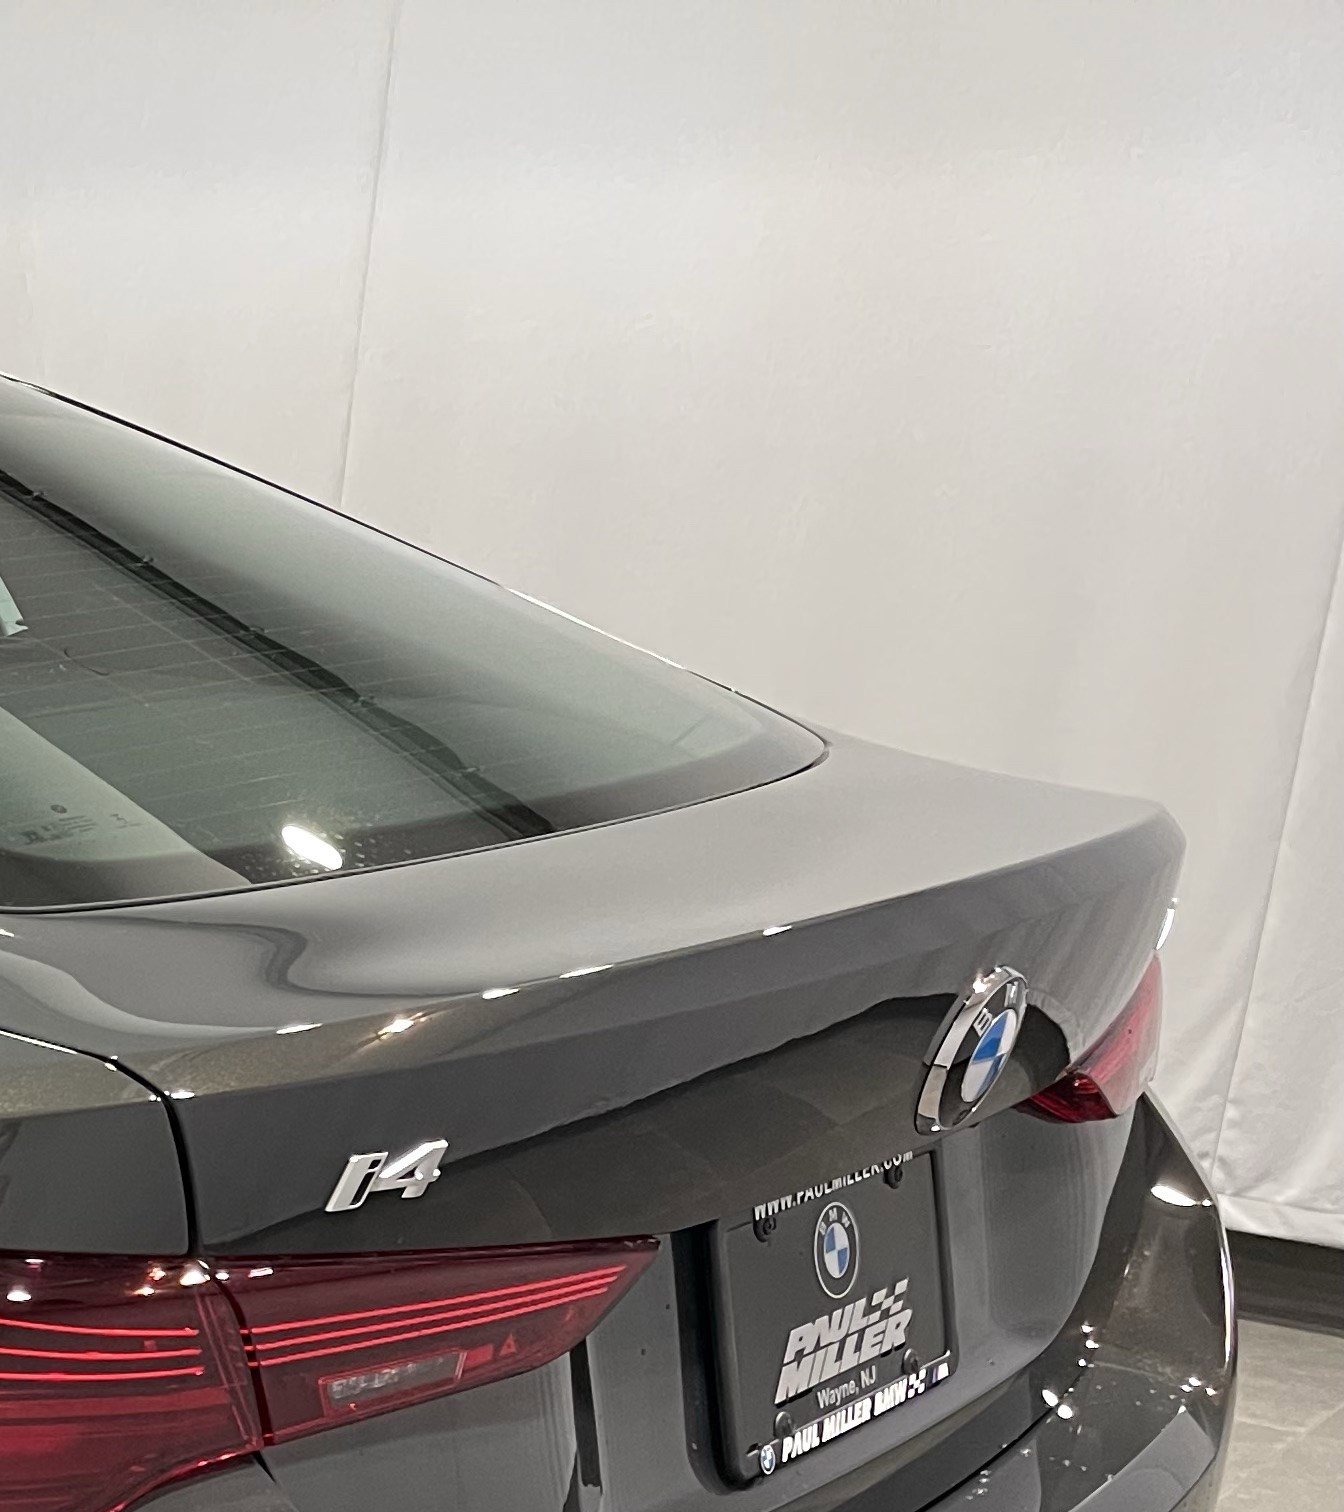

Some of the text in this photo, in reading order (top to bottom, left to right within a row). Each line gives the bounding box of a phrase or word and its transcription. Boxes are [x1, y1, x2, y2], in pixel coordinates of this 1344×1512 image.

[325, 1139, 449, 1213] i4
[819, 1207, 851, 1236] BMW
[774, 1308, 914, 1405] MILLER
[782, 1296, 871, 1364] PAUL
[781, 1423, 820, 1463] PAUL
[822, 1397, 872, 1443] MILLER
[873, 1377, 908, 1417] BMW
[817, 1365, 877, 1409] Wayne, NJ
